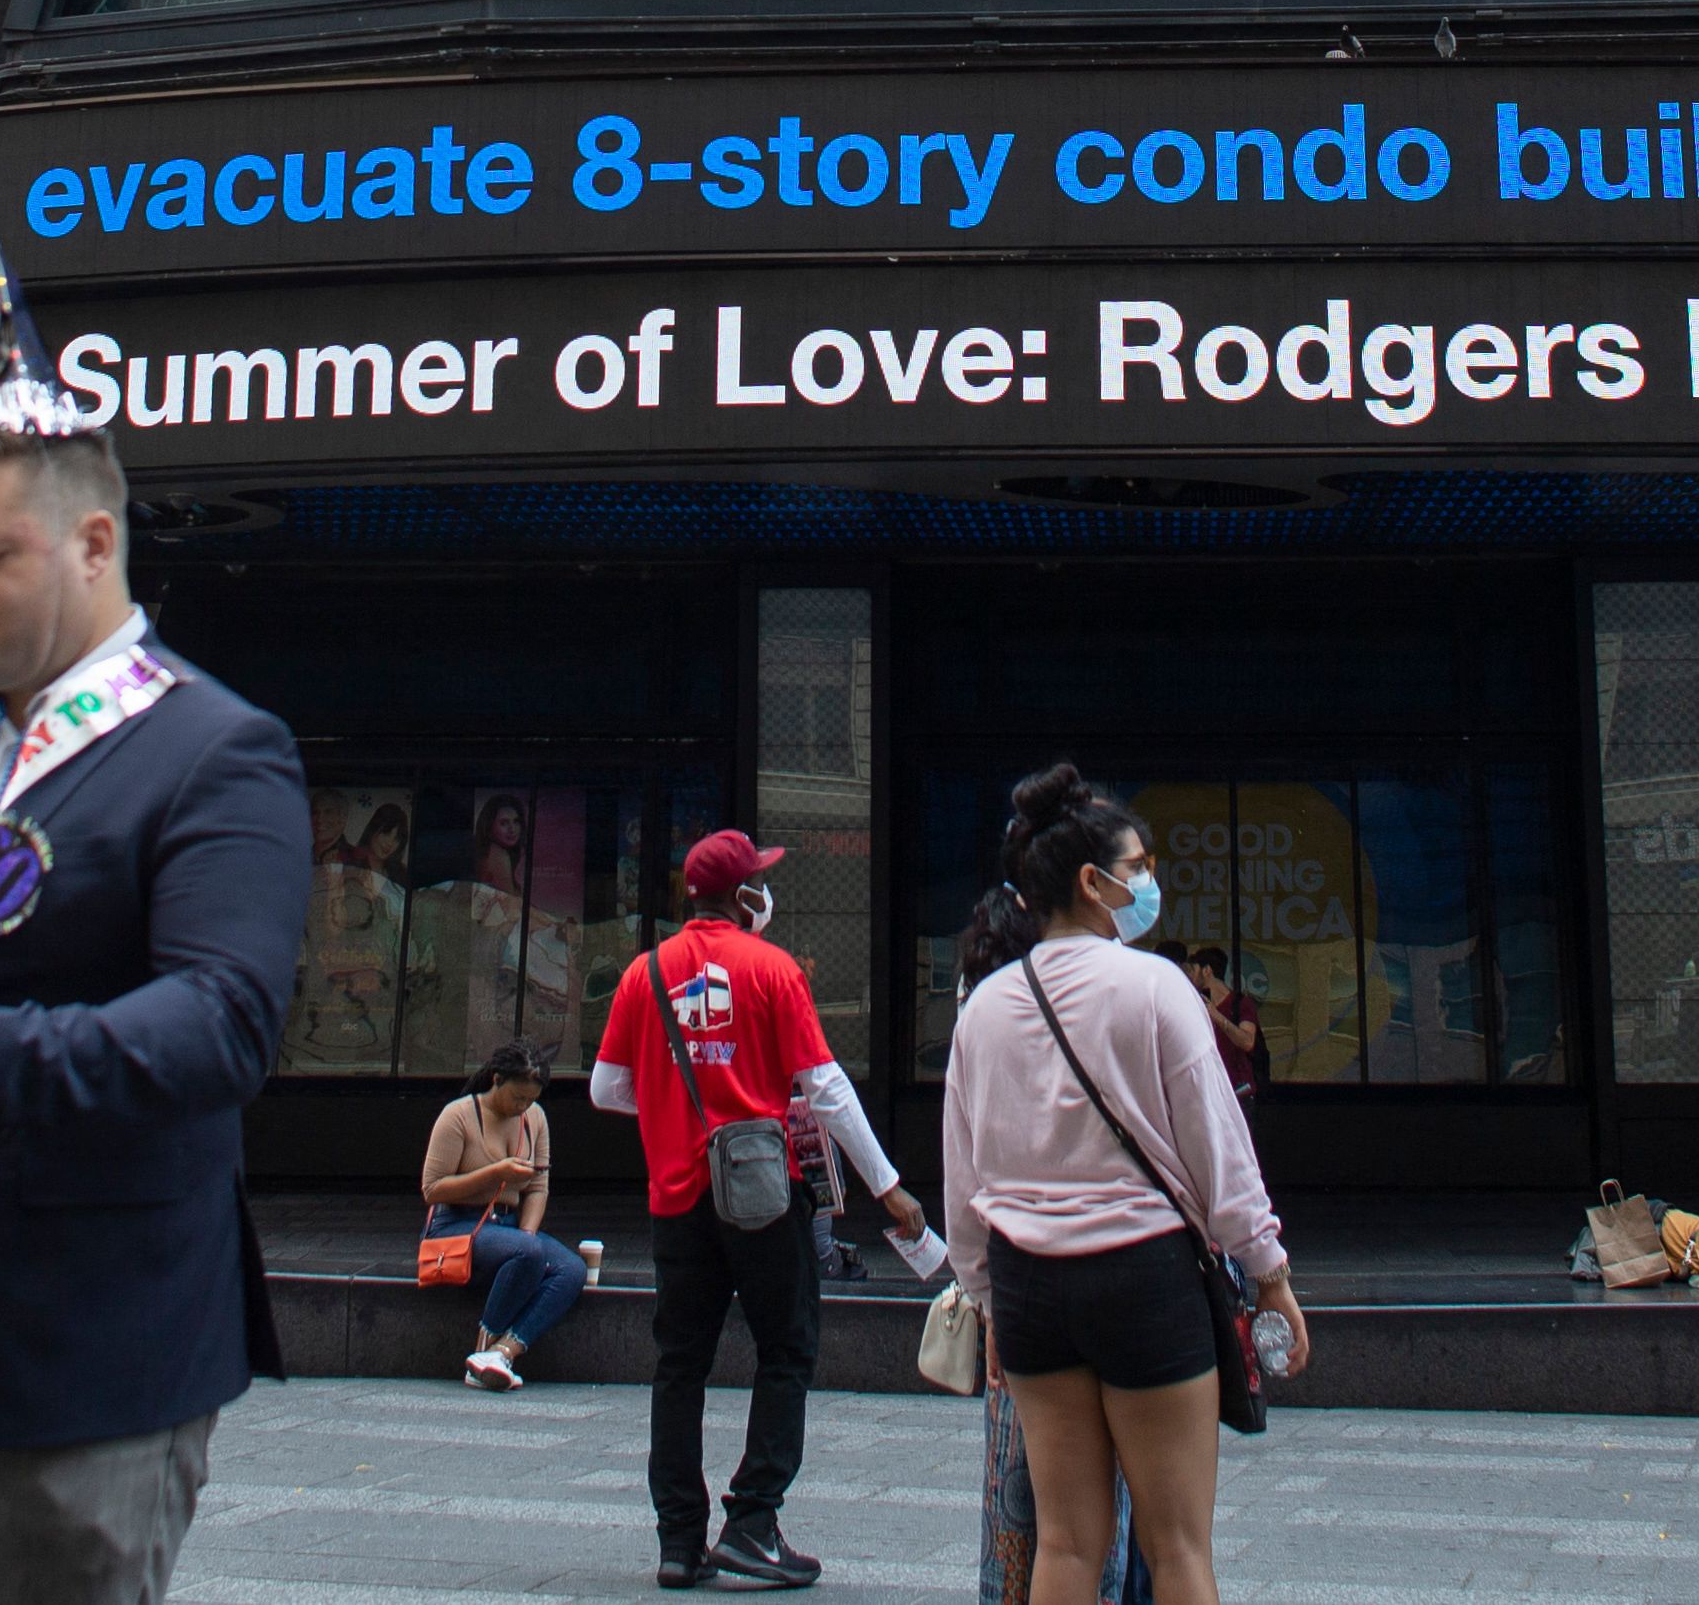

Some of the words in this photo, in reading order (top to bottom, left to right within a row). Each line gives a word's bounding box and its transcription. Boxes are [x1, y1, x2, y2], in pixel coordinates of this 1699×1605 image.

[27, 126, 534, 238] evacuate
[572, 115, 1015, 229] 8-story
[1056, 103, 1452, 204] condo
[59, 332, 518, 429] Summer
[555, 309, 675, 411] of
[716, 306, 1047, 406] Love:
[1099, 299, 1646, 428] Rodgers
[55, 691, 102, 726] TO
[1167, 823, 1293, 856] GOOD
[1150, 895, 1354, 940] MERICA
